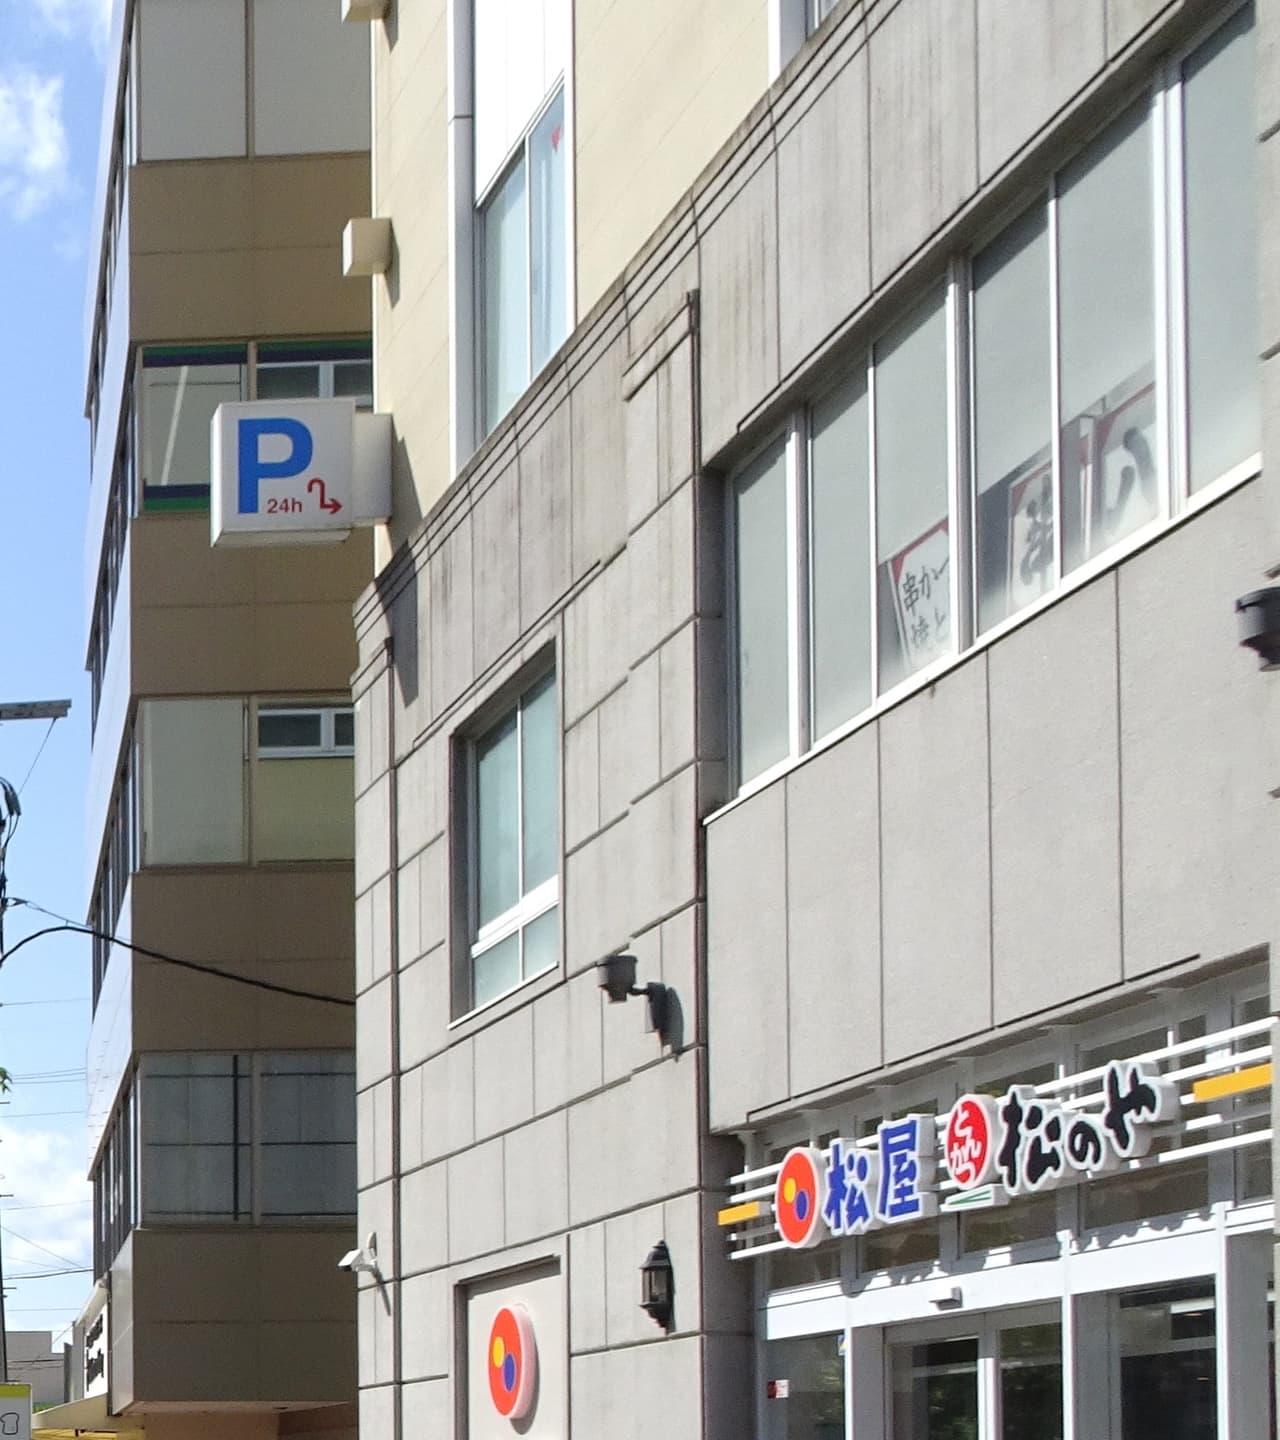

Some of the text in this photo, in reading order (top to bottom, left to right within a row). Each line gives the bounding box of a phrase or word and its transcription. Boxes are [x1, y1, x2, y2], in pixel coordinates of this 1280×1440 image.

[237, 417, 313, 514] P
[266, 498, 303, 514] 24h
[823, 1118, 921, 1231] 松屋
[998, 1065, 1158, 1189] 松のや
